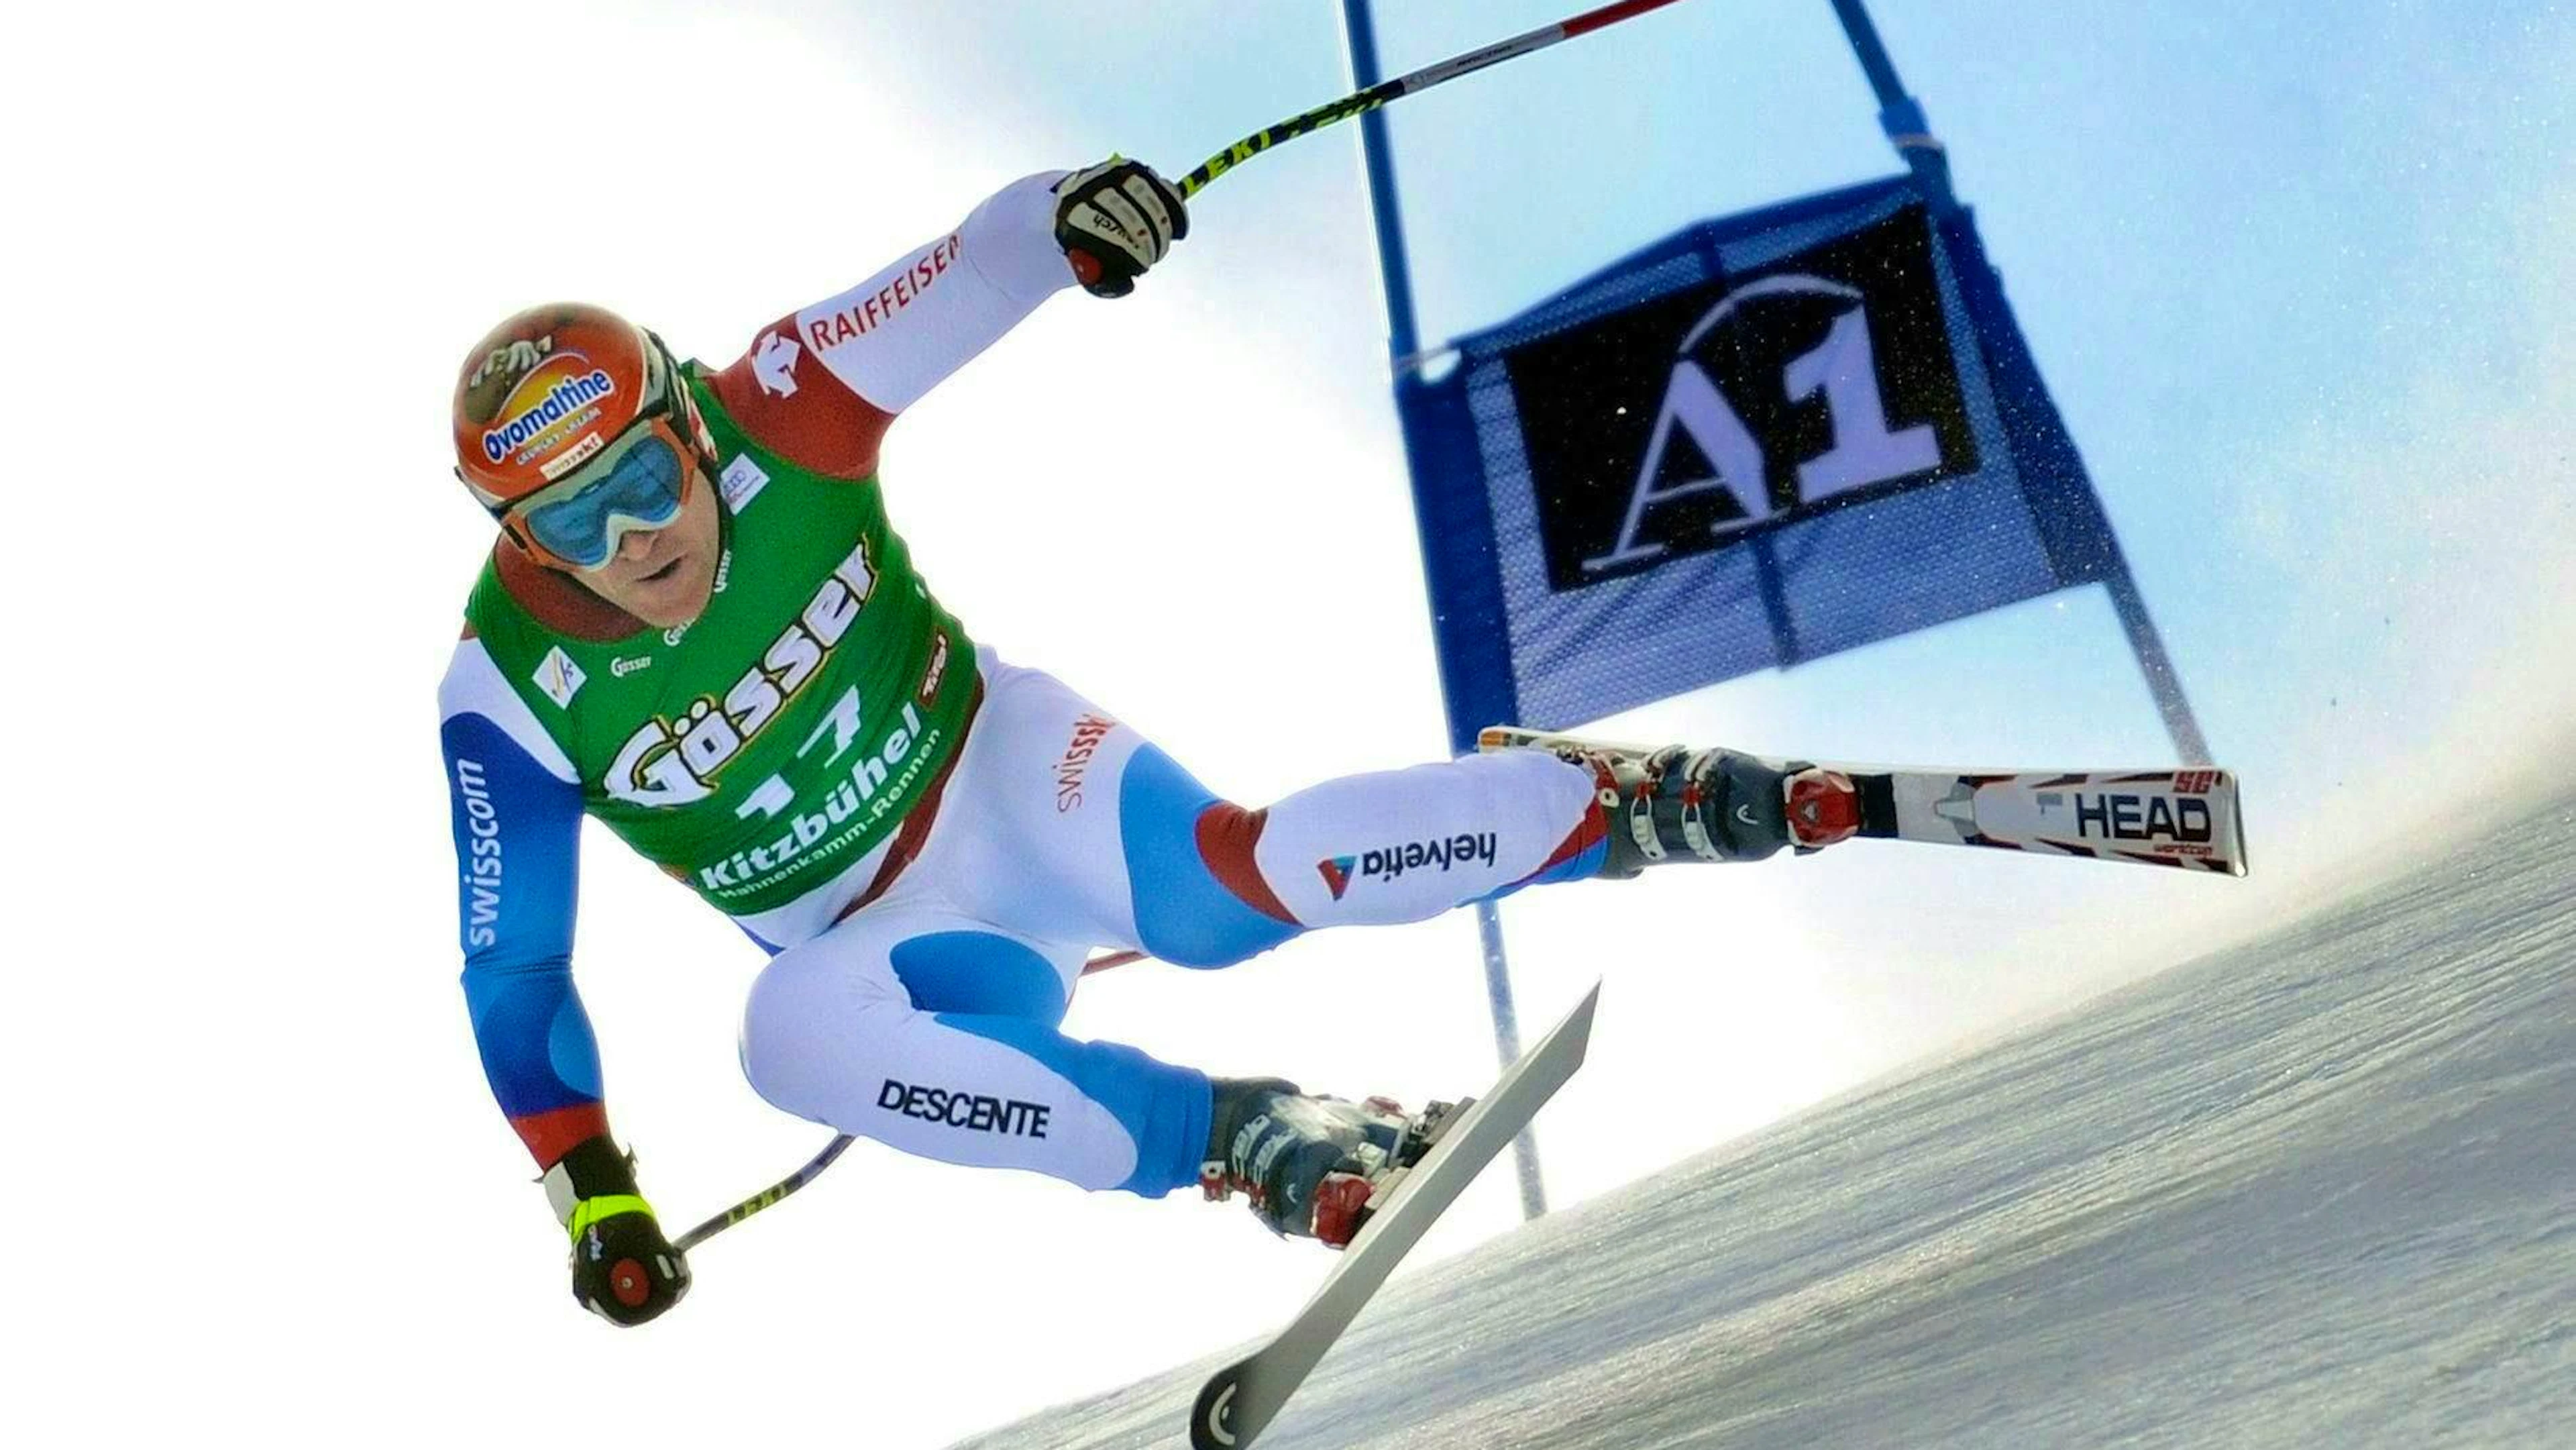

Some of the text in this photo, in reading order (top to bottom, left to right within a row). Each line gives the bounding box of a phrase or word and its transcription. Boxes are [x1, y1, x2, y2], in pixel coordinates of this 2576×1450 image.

[1185, 129, 1273, 197] LEKI
[482, 370, 614, 464] Ovomaltine
[1582, 274, 1942, 572] A1
[602, 539, 875, 807] Gösser
[700, 701, 922, 890] Kitzbühel
[2075, 793, 2212, 843] HEAD
[457, 758, 502, 947] swisscom
[1362, 832, 1497, 882] helvetia
[877, 1078, 1050, 1139] DESCENTE
